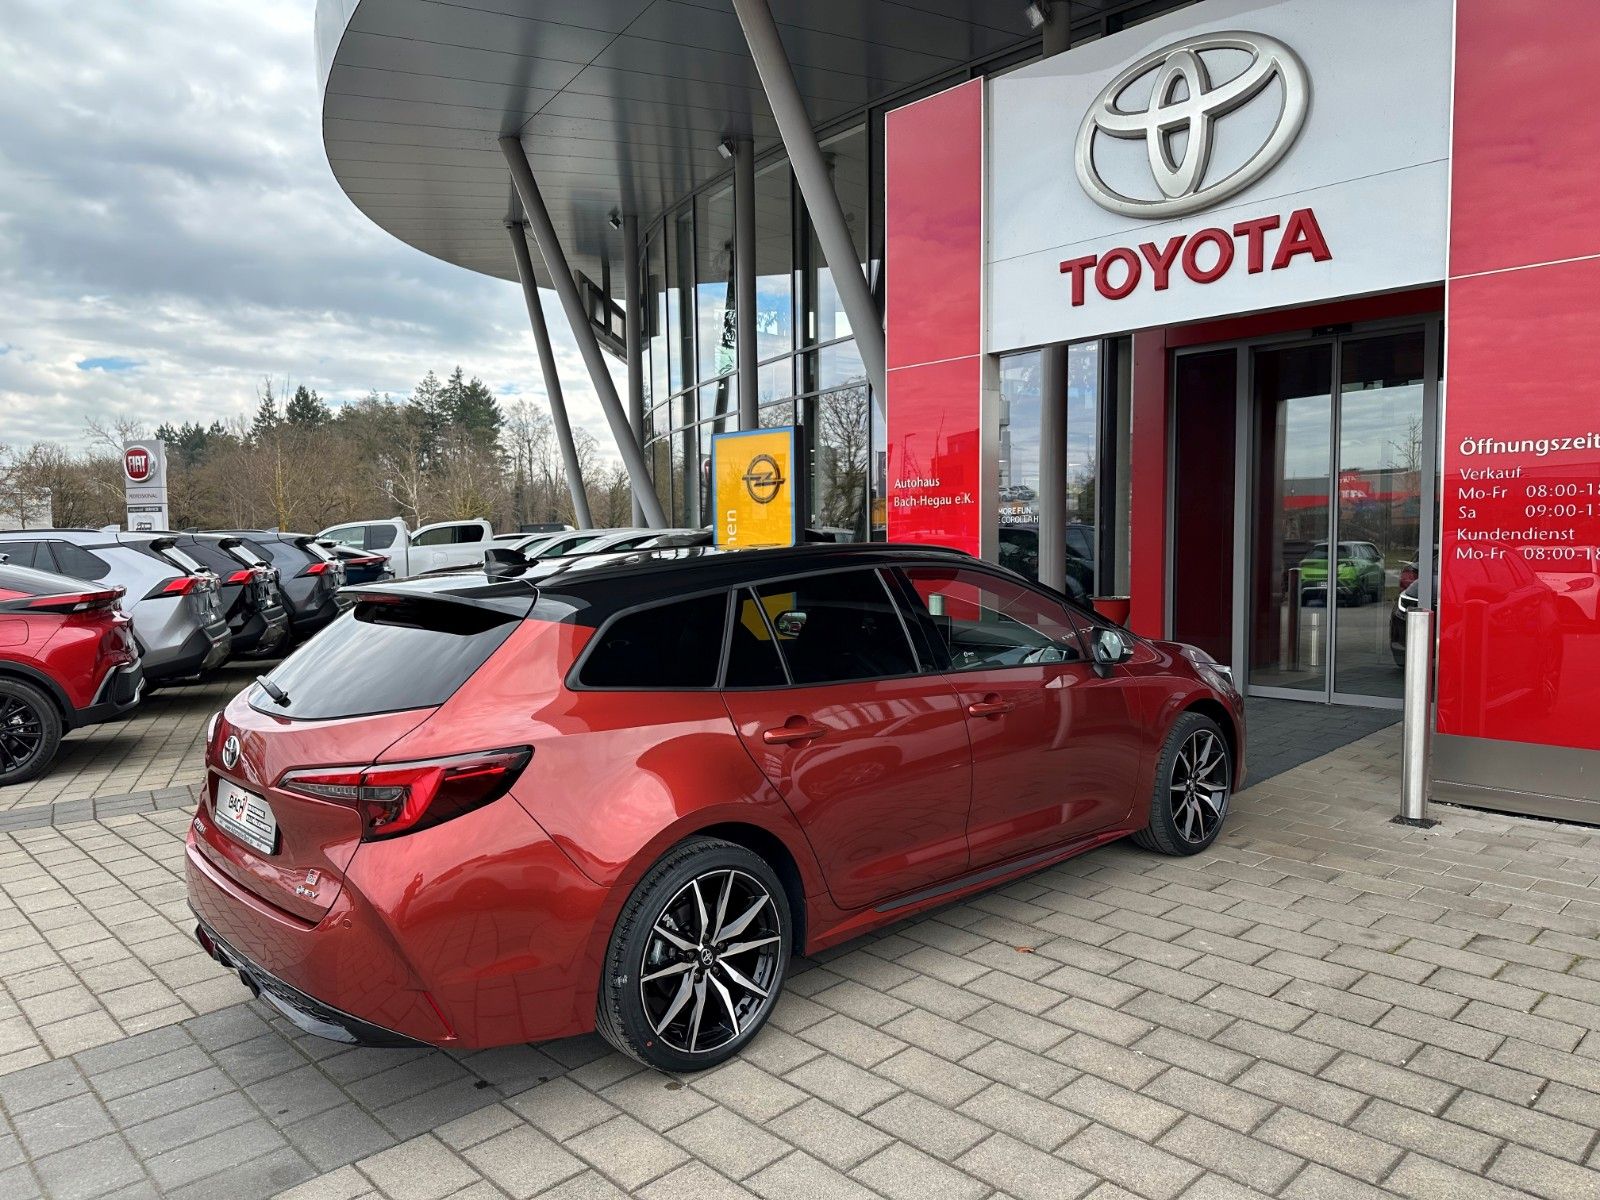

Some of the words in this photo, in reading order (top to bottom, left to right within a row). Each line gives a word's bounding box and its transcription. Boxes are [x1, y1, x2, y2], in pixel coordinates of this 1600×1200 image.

[1060, 207, 1333, 307] TOYOTA
[127, 455, 147, 473] FIAT
[1460, 466, 1522, 480] Verkauf
[894, 476, 940, 489] Autohaus
[1458, 486, 1508, 500] Mo-Fr
[894, 494, 952, 509] Bach-Hegau
[954, 492, 975, 504] e.K.
[1458, 505, 1477, 519] Sa
[1525, 503, 1600, 518] 09:00-1
[1457, 527, 1575, 541] Kundendienst
[1456, 546, 1506, 560] Mo-Fr
